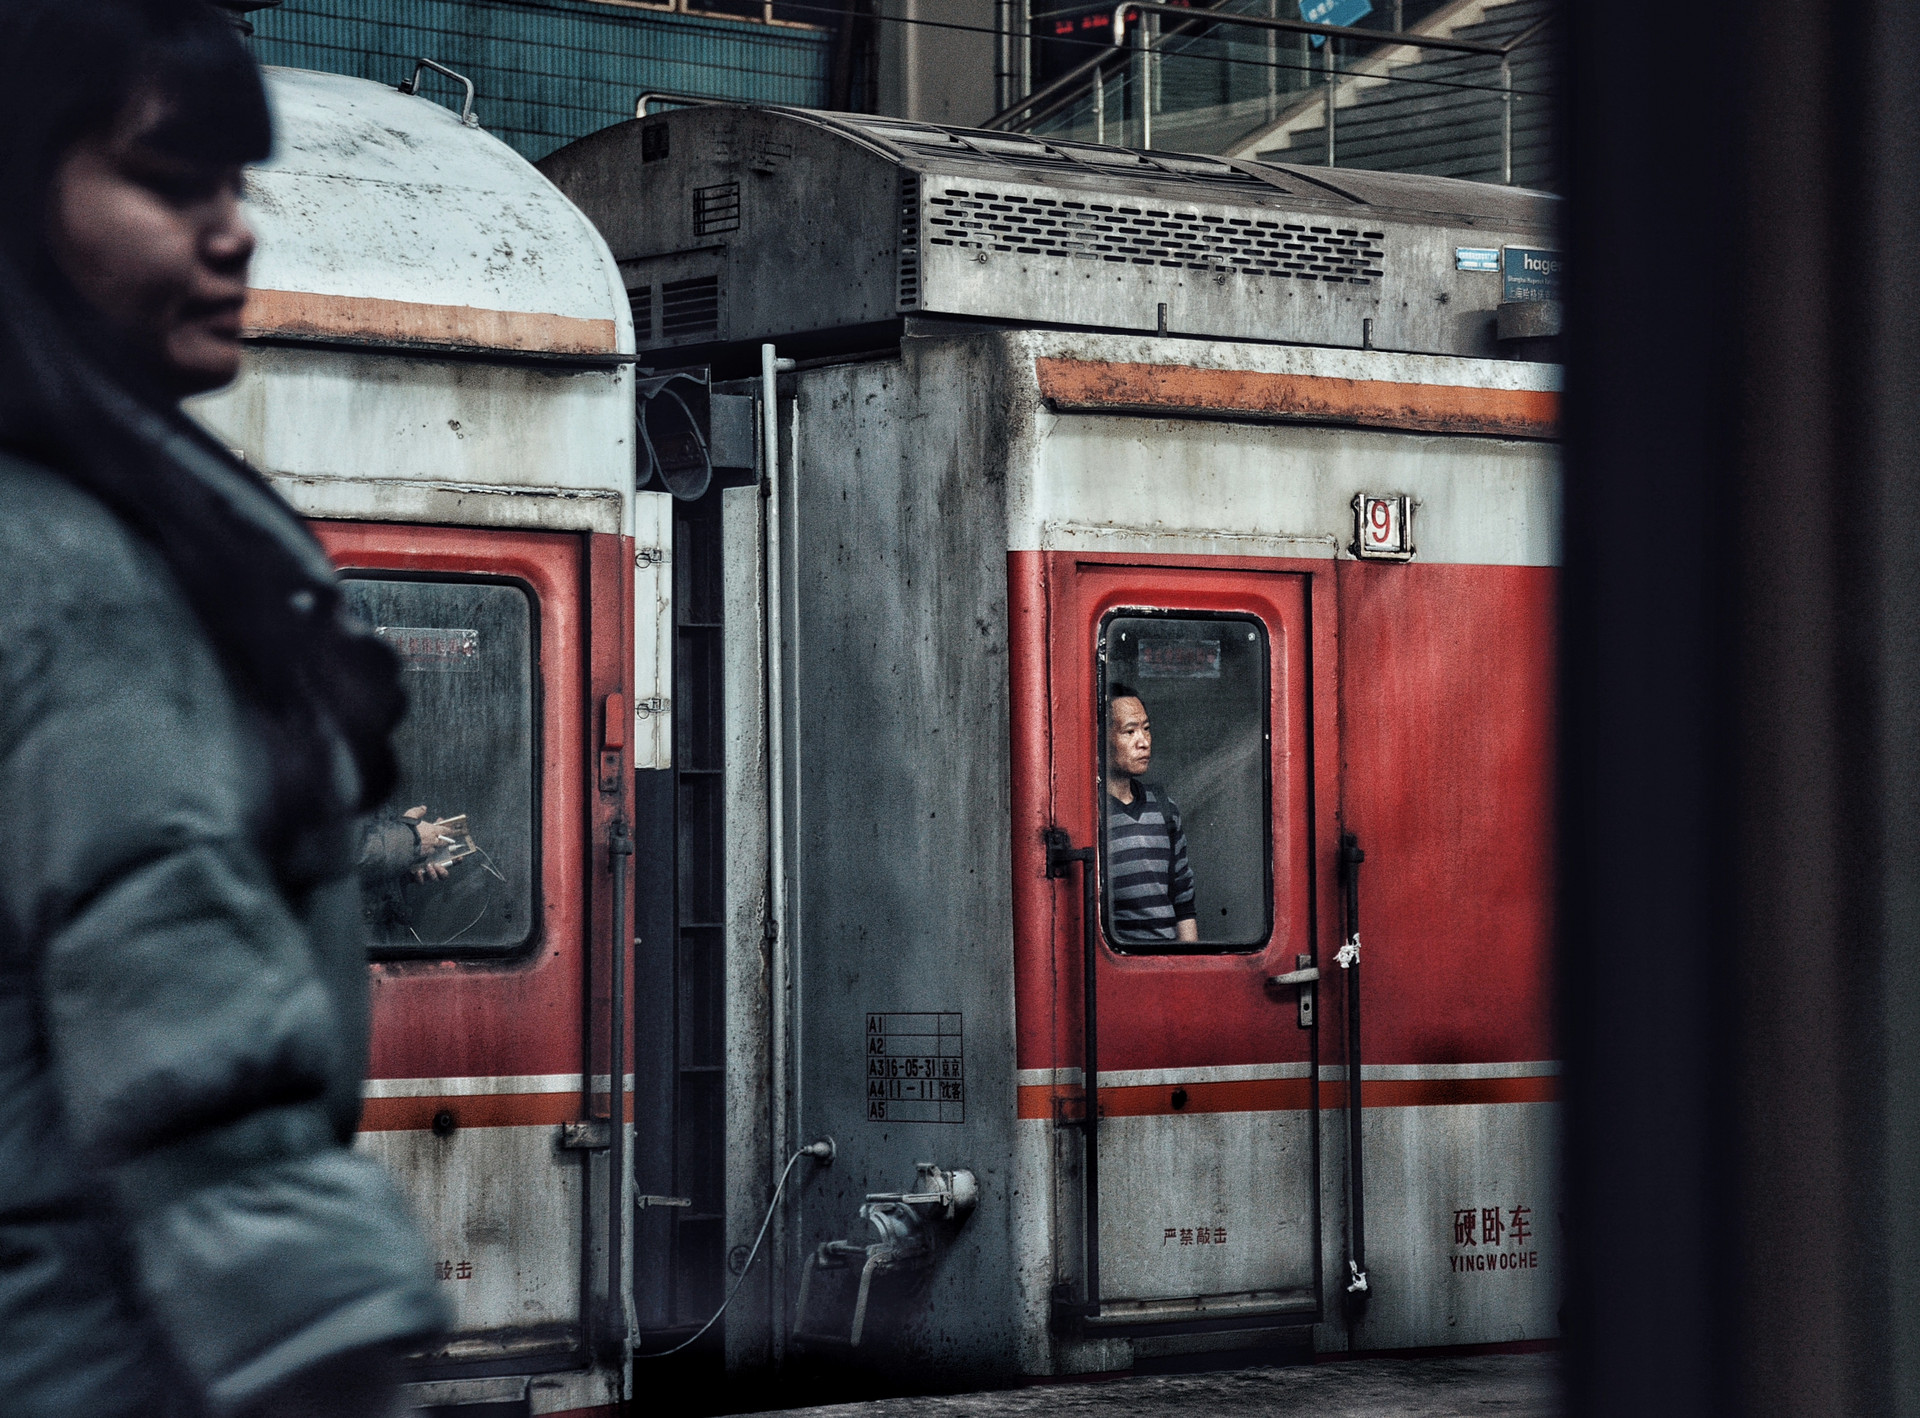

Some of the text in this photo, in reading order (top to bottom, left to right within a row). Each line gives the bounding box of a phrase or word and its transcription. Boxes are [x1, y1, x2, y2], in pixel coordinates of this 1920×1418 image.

[1371, 500, 1391, 544] 9
[868, 1015, 883, 1033] A1
[868, 1037, 884, 1055] A2
[869, 1058, 885, 1077] A3
[886, 1058, 936, 1078] 16-05-31
[869, 1080, 885, 1098] A4
[869, 1101, 886, 1119] A5
[1453, 1204, 1532, 1248] 硬卧车
[1163, 1226, 1228, 1247] 严禁敲击
[1449, 1251, 1538, 1273] YINGWOCHE
